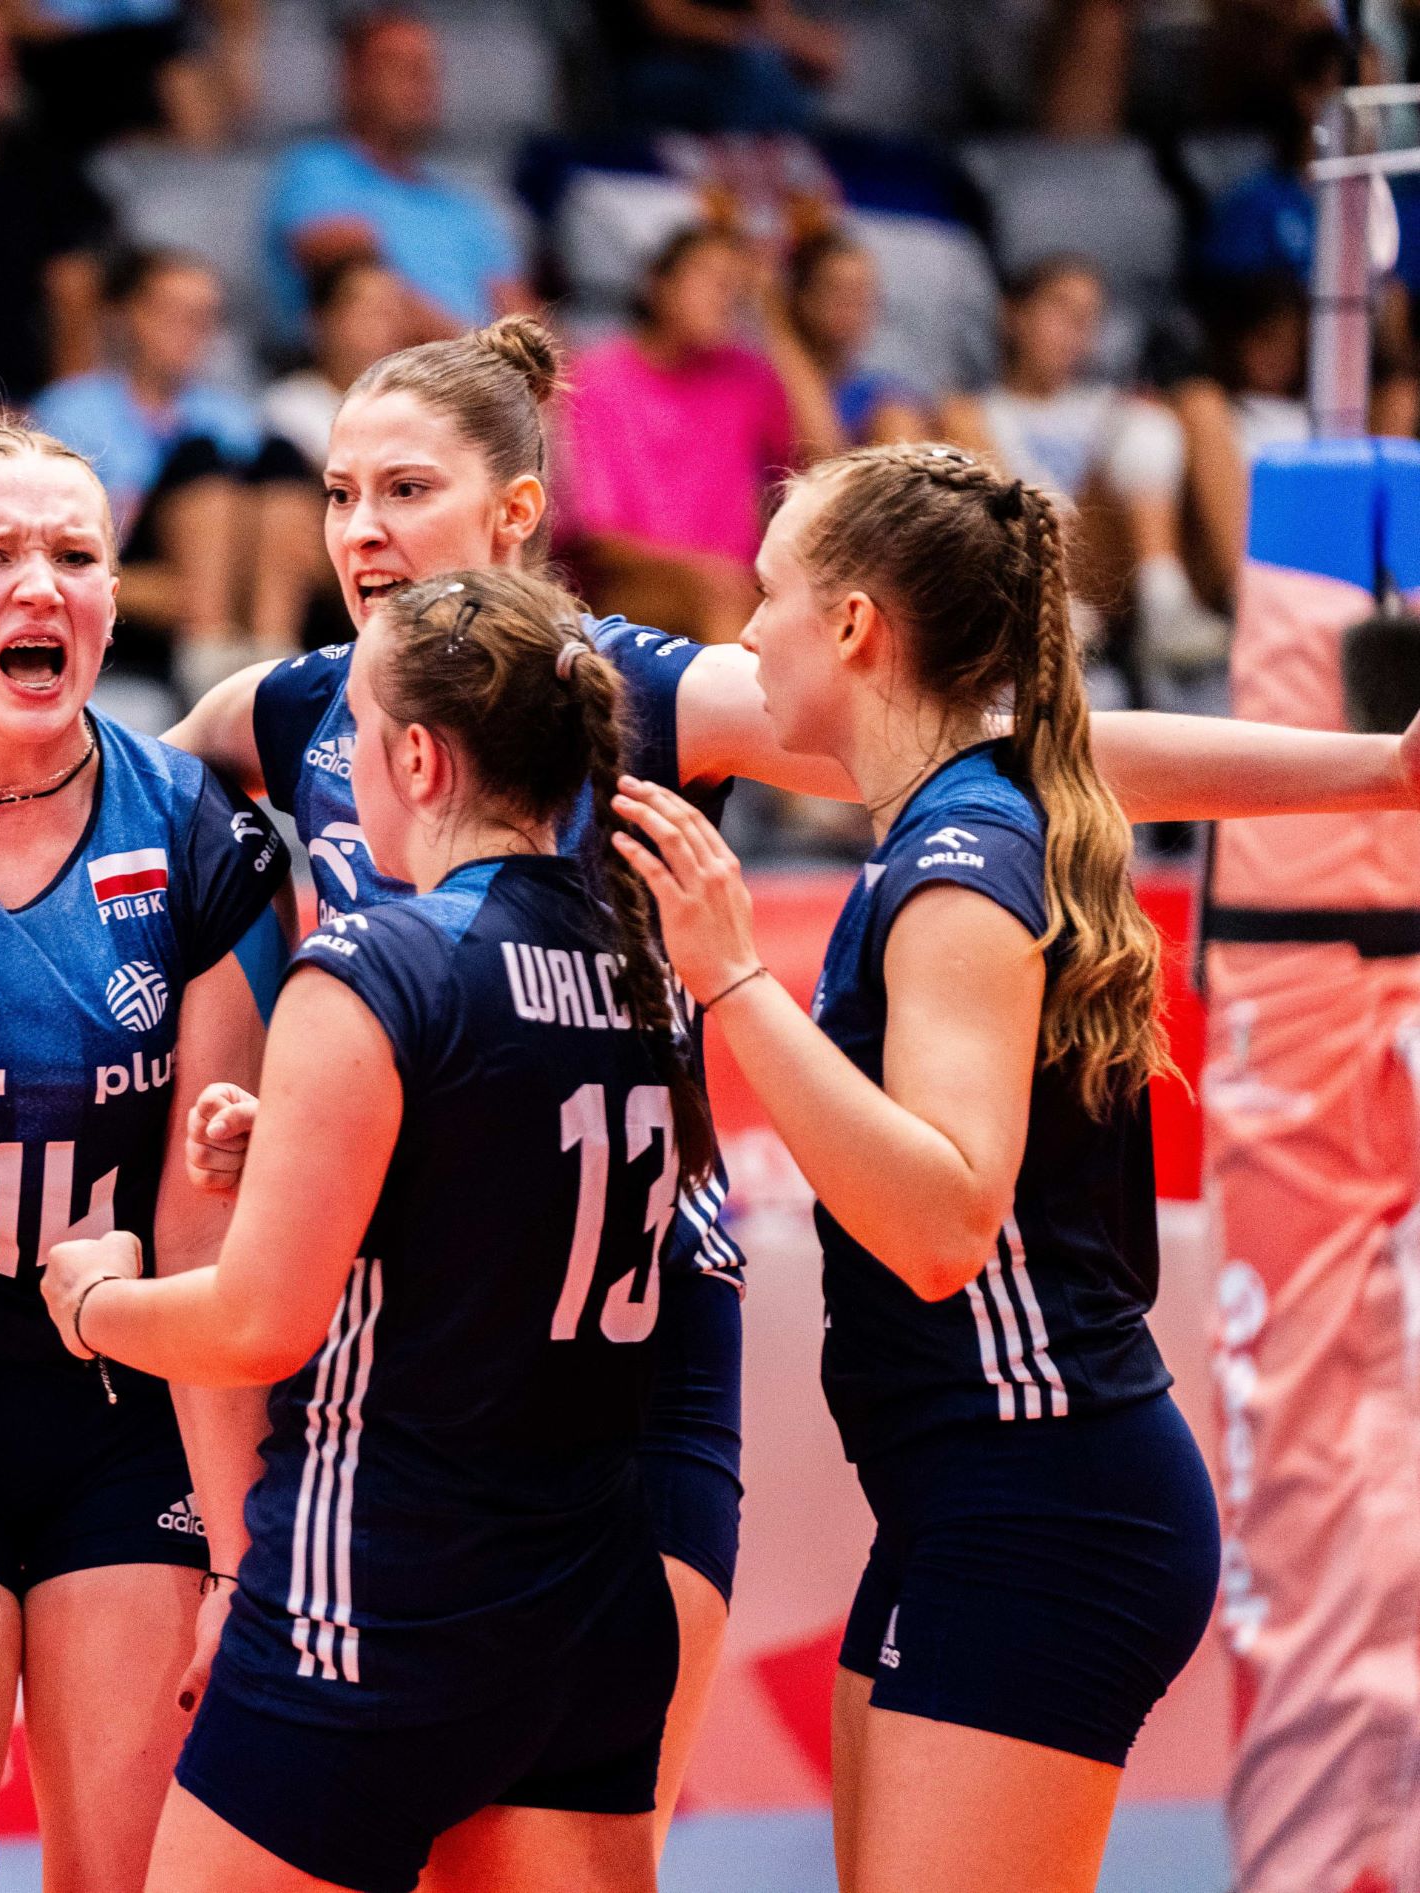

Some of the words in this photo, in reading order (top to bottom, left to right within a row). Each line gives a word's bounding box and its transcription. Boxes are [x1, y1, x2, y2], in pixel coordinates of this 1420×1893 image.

[306, 747, 352, 780] adid
[917, 852, 985, 869] ORLEN
[97, 893, 165, 925] POLSK
[500, 941, 686, 1034] WALC
[95, 1051, 175, 1105] plu
[550, 1083, 679, 1343] 13
[157, 1512, 207, 1538] adid
